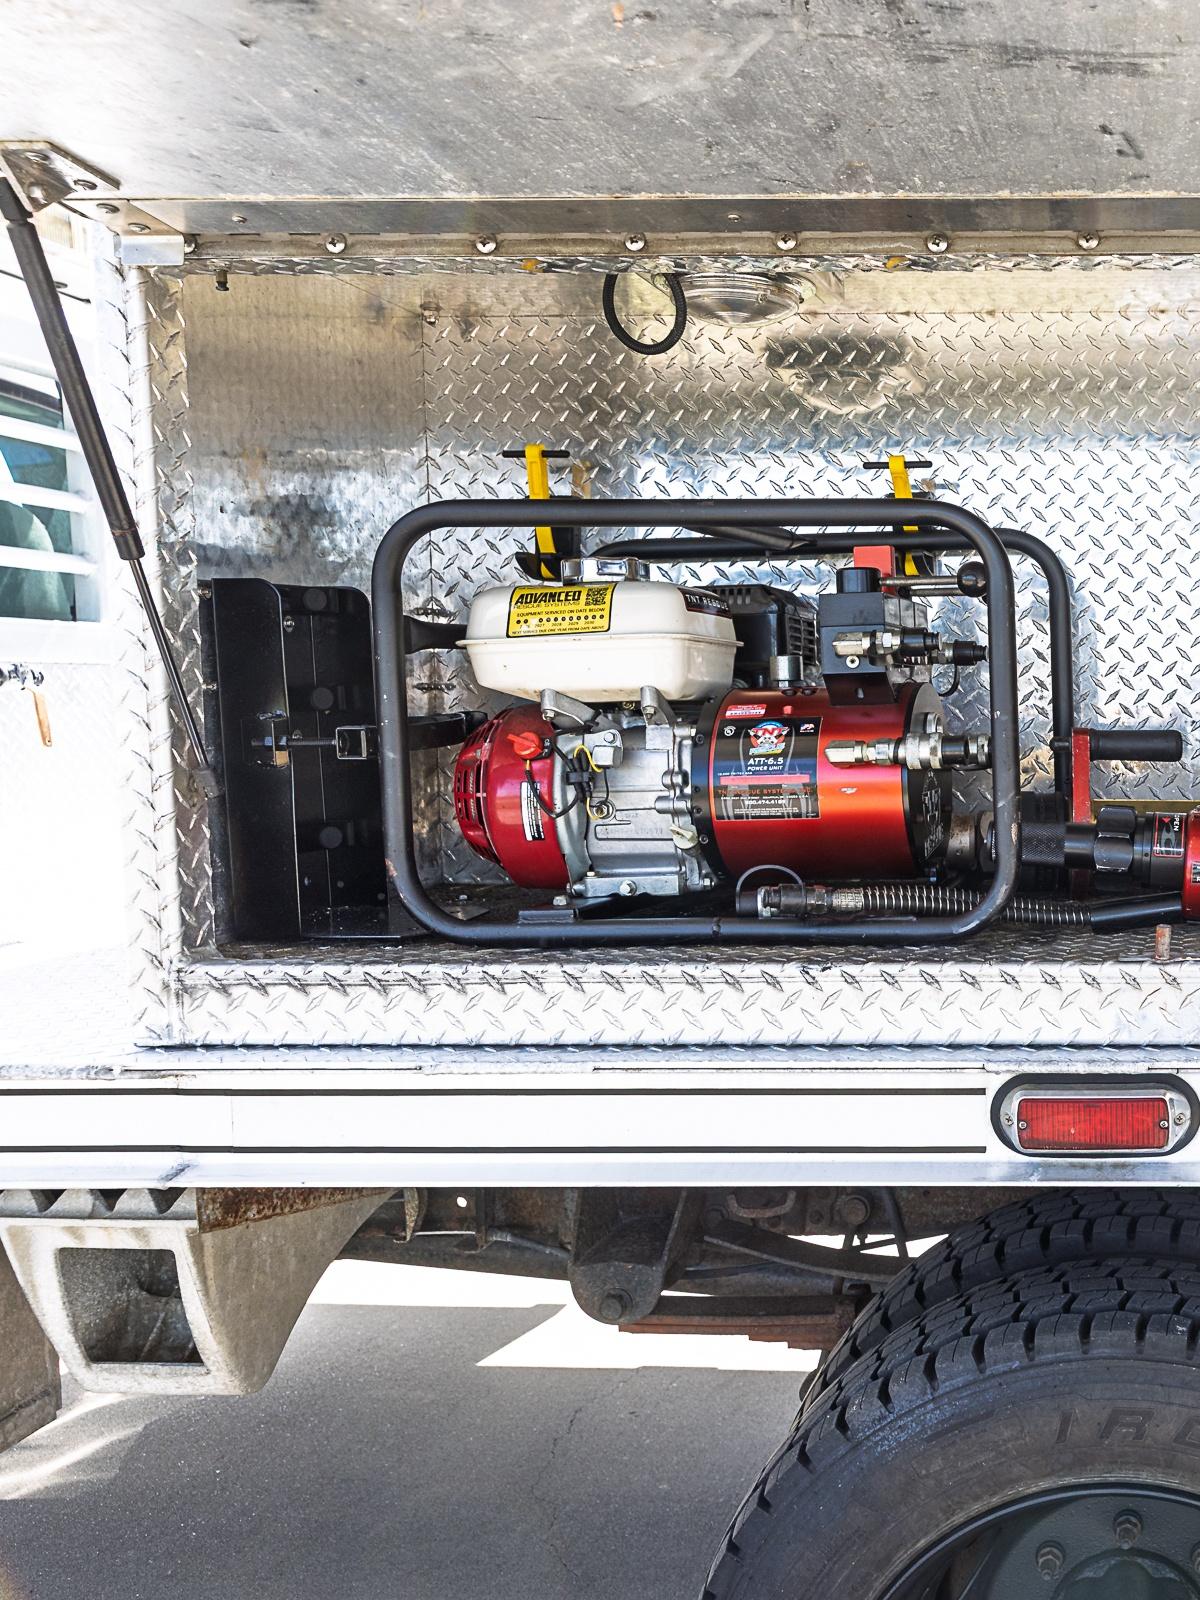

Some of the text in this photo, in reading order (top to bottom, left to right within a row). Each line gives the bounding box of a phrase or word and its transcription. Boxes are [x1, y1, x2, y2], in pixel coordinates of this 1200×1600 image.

[514, 590, 582, 606] ADVANCED
[685, 594, 729, 610] TNT RESCUE
[747, 757, 784, 765] ATT-6.5
